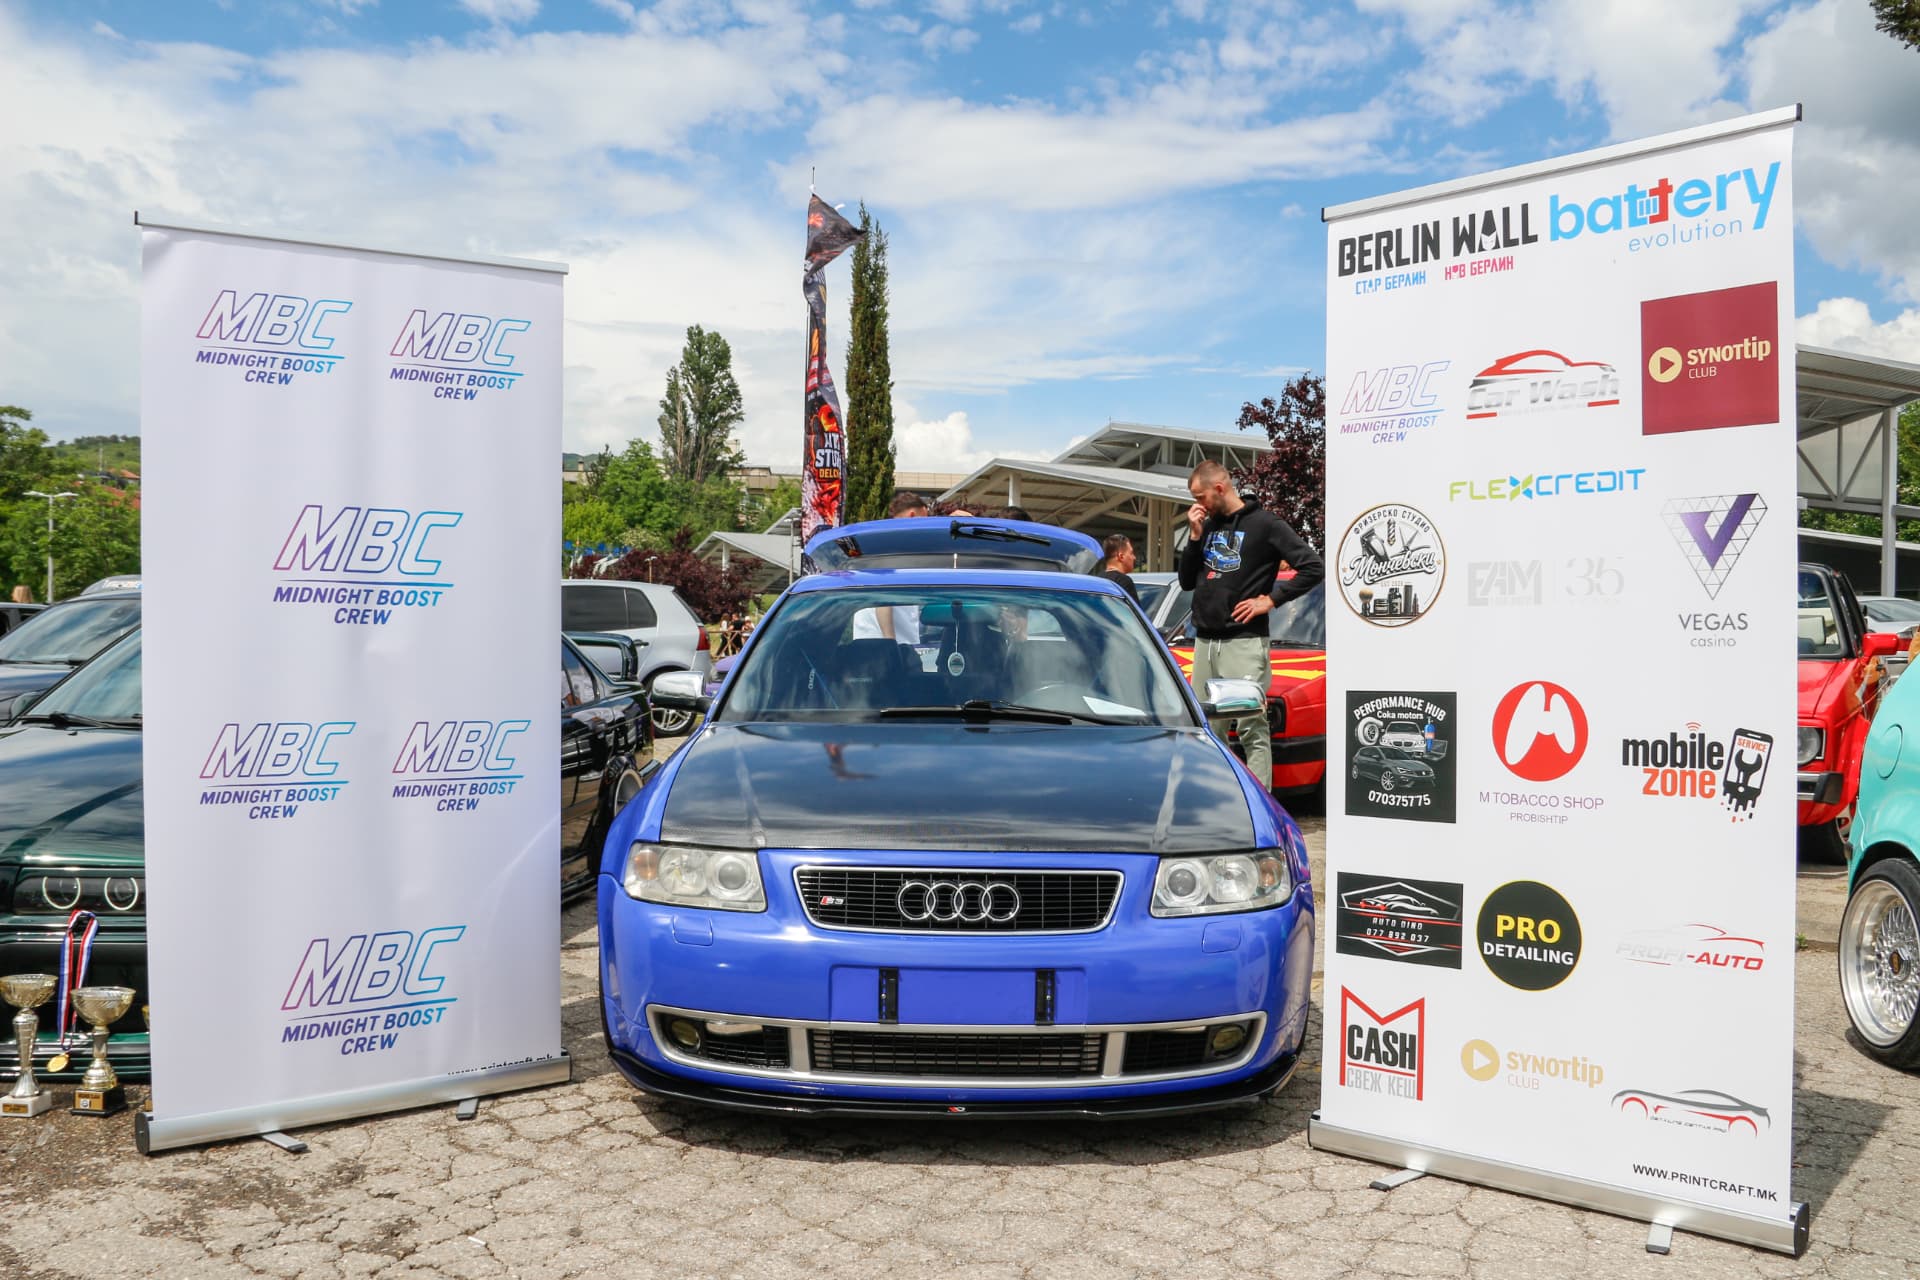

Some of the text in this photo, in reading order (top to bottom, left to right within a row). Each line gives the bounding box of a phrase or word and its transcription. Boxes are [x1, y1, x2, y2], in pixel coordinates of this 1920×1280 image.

[1550, 161, 1780, 241] battery
[1338, 203, 1538, 277] BERLIN WALL
[1629, 219, 1742, 252] evolution
[1470, 256, 1513, 276] БЕРЛИН
[1385, 270, 1426, 290] БЕРЛИН
[196, 290, 353, 350] MBC
[390, 309, 532, 366] MBC
[196, 350, 336, 374] MIDNIGHT BOOST
[1689, 366, 1717, 379] CLUB
[244, 369, 294, 385] CREW
[390, 367, 515, 390] MIDNIGHT BOOST
[1340, 360, 1451, 415] MBC
[434, 386, 478, 401] CREW
[1468, 388, 1520, 410] Car
[1530, 374, 1619, 404] Wash
[1340, 416, 1438, 434] MIDNIGHT BOOST
[1372, 431, 1407, 444] CREW
[1354, 509, 1430, 535] ФРИЗЕРСКО СТУДИО
[272, 504, 464, 576] MBC
[1343, 549, 1436, 586] Мончевски
[273, 586, 444, 607] MIDNIGHT BOOST
[334, 607, 392, 625] CREW
[1679, 613, 1748, 631] VEGAS
[1690, 635, 1736, 648] casino
[1353, 696, 1447, 721] PERFORMANCE HUB
[1377, 710, 1424, 720] Coka motors
[200, 721, 357, 778] MBC
[392, 720, 531, 773] MBC
[1622, 732, 1724, 770] mobile
[1737, 737, 1767, 753] SERVICE
[392, 781, 515, 798] MIDNIGHT BOOST
[1642, 768, 1716, 799] zone
[200, 787, 341, 806] MIDNIGHT BOOST
[436, 798, 480, 812] CREW
[1368, 790, 1431, 807] 070375775
[1480, 791, 1604, 810] M TOBACCO SHOP
[248, 804, 298, 820] CREW
[1509, 812, 1569, 825] PROBISHTIP
[1366, 928, 1430, 943] 077 892 037
[1496, 914, 1561, 944] PRO
[1483, 942, 1574, 966] DETAILING
[1616, 942, 1764, 970] PROFI-AUTO
[281, 925, 467, 1011] MBC
[281, 1007, 447, 1043] MIDNIGHT BOOST
[340, 1033, 398, 1056] CREW
[1347, 1024, 1416, 1070] CASH
[1347, 1068, 1416, 1099] СВЕЖ КЕШ
[1507, 1074, 1540, 1090] CLUB
[1632, 1163, 1778, 1202] WWW.PRINTCRAFT.MK
